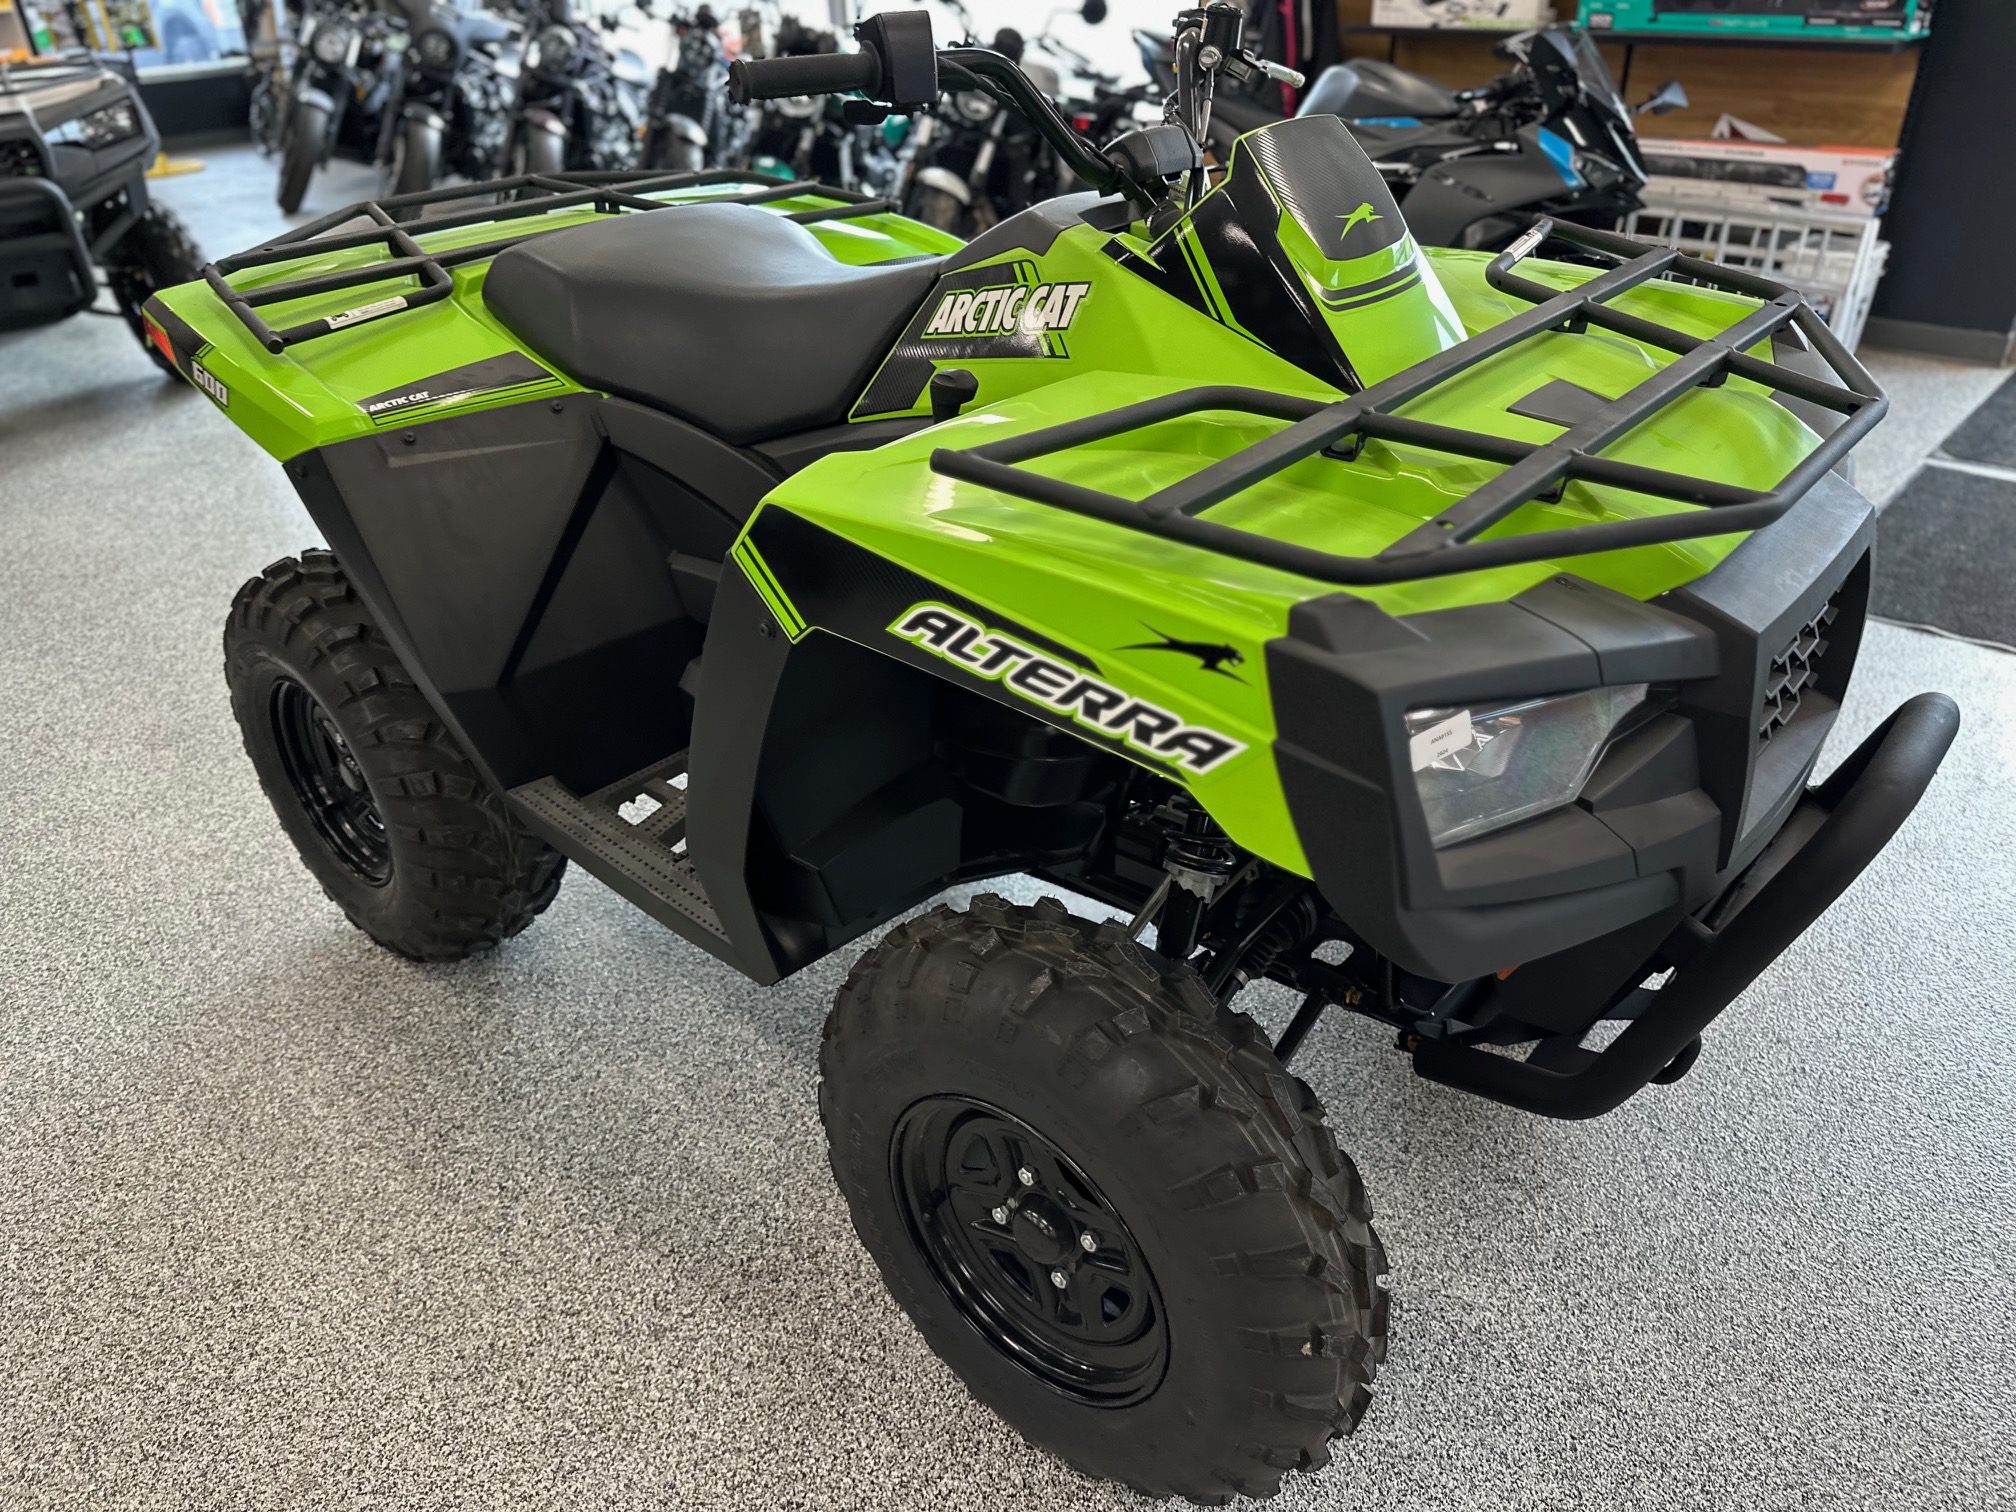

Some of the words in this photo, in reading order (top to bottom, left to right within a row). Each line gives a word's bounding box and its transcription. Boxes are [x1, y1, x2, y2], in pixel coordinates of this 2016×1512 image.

[926, 286, 1028, 334] ARCTIC
[1023, 283, 1090, 329] CAT
[191, 360, 228, 406] 600
[369, 396, 409, 412] ARCTIC
[408, 391, 430, 402] CAT
[896, 607, 1245, 774] ALTERRA
